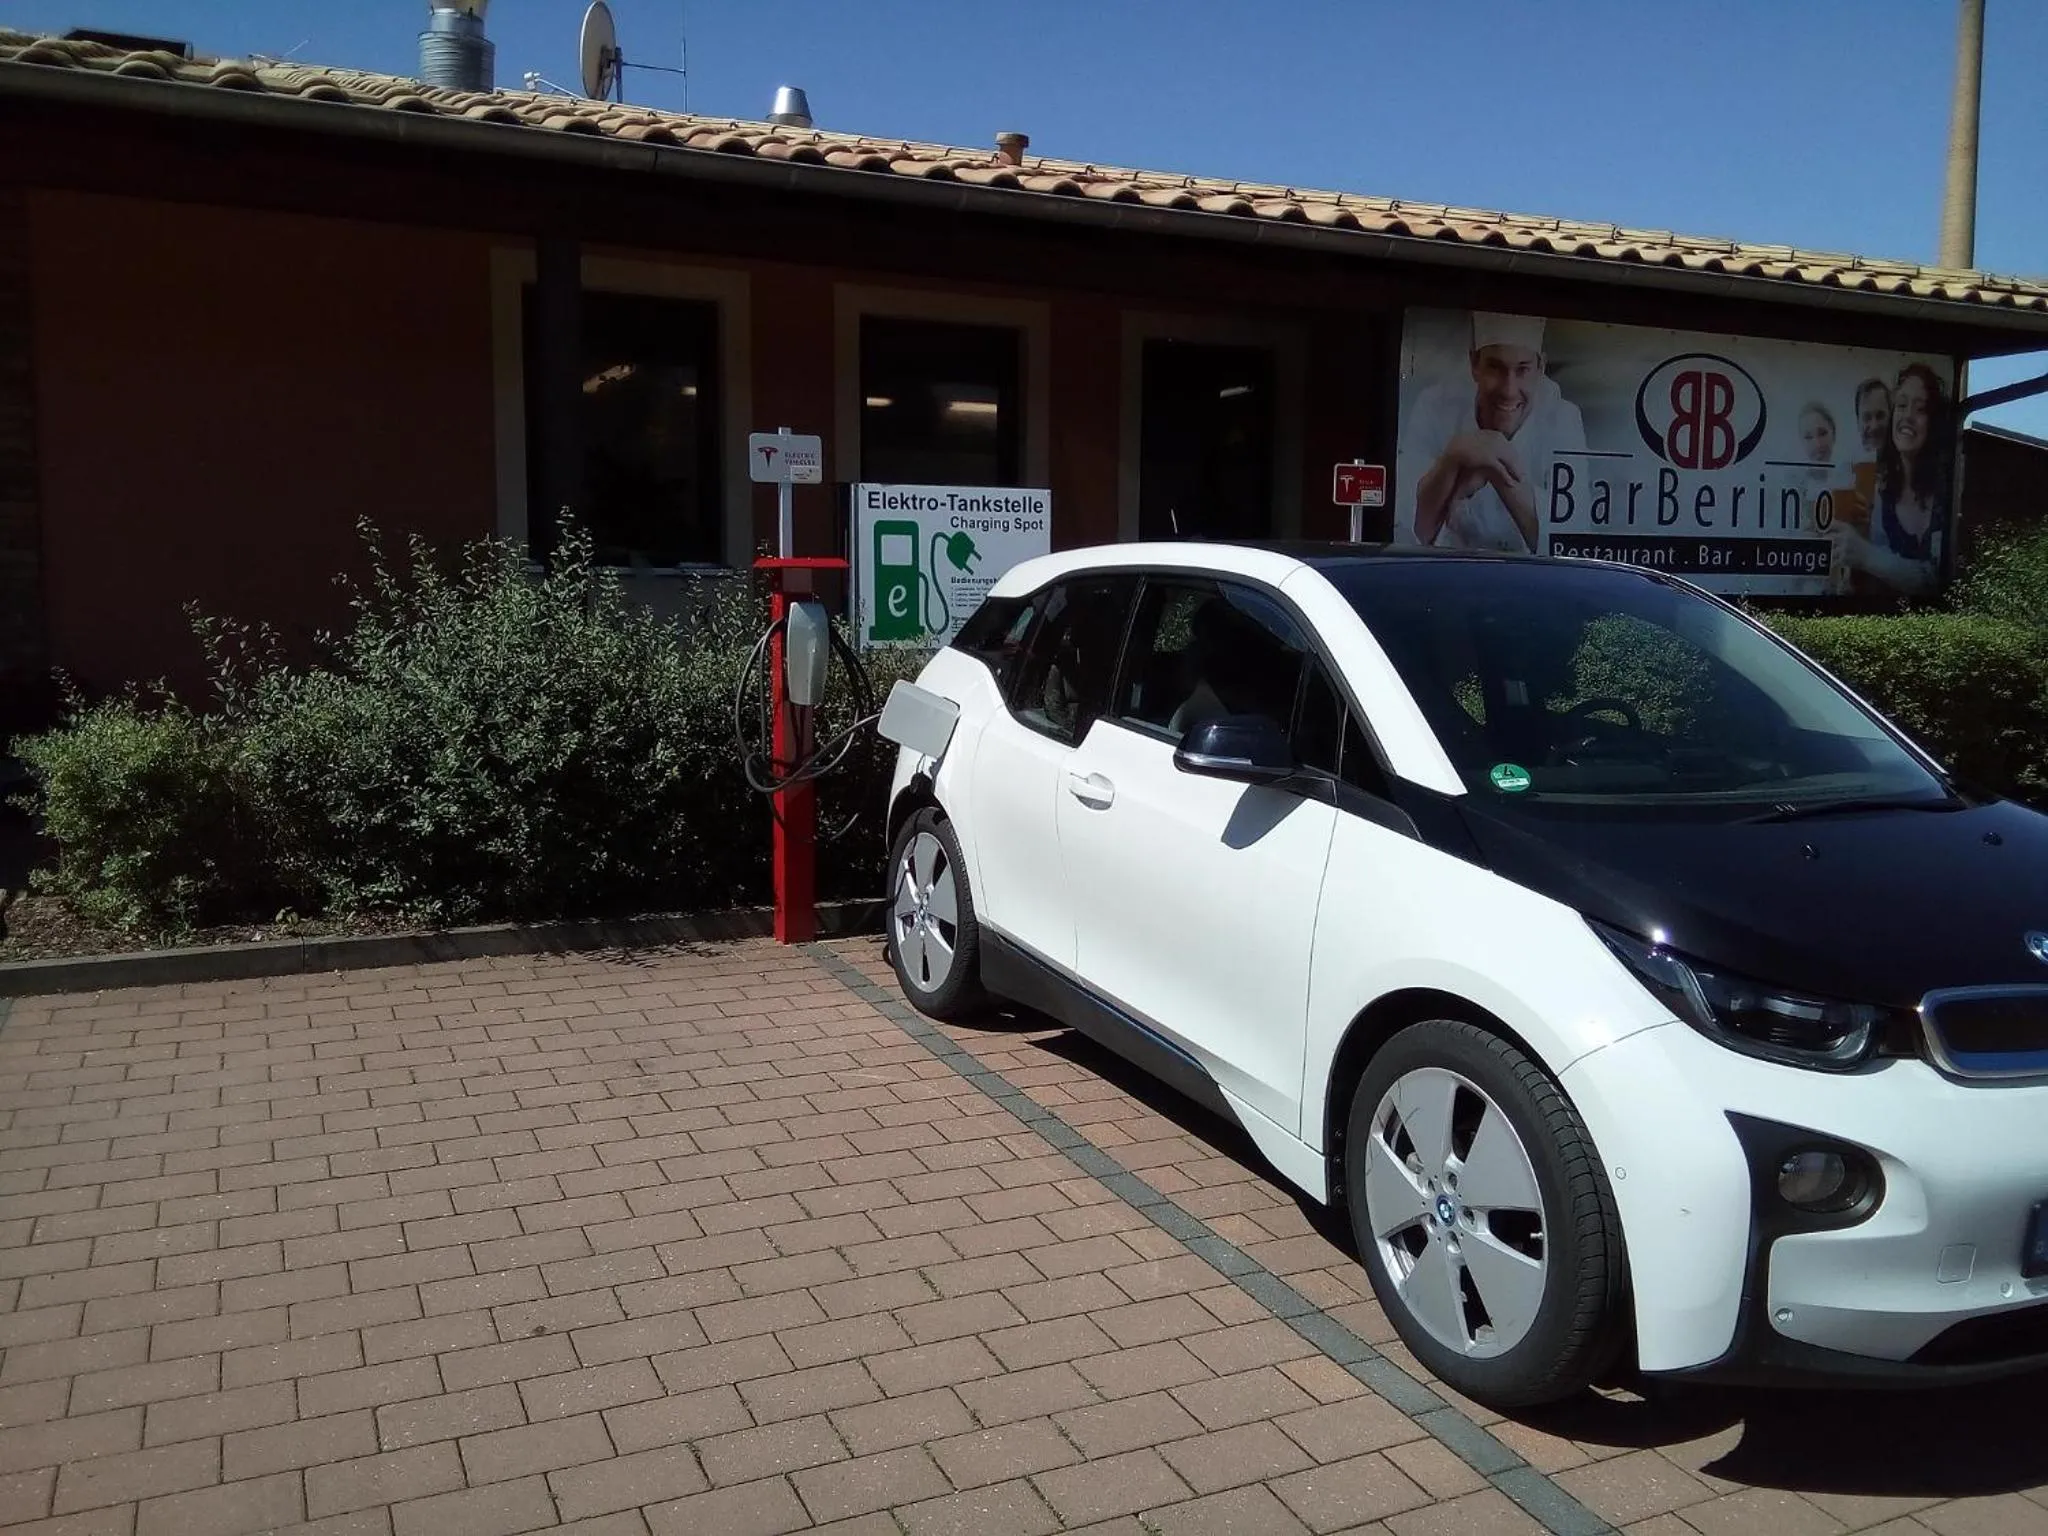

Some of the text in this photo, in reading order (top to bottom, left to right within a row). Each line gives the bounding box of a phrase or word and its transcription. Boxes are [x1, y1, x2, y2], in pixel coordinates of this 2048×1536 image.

[867, 491, 1044, 513] Elektro-Tankstelle
[1549, 463, 1834, 531] BarBerino
[950, 516, 1043, 532] Charging Spot
[1553, 542, 1829, 572] Restaurant Bar Lounge
